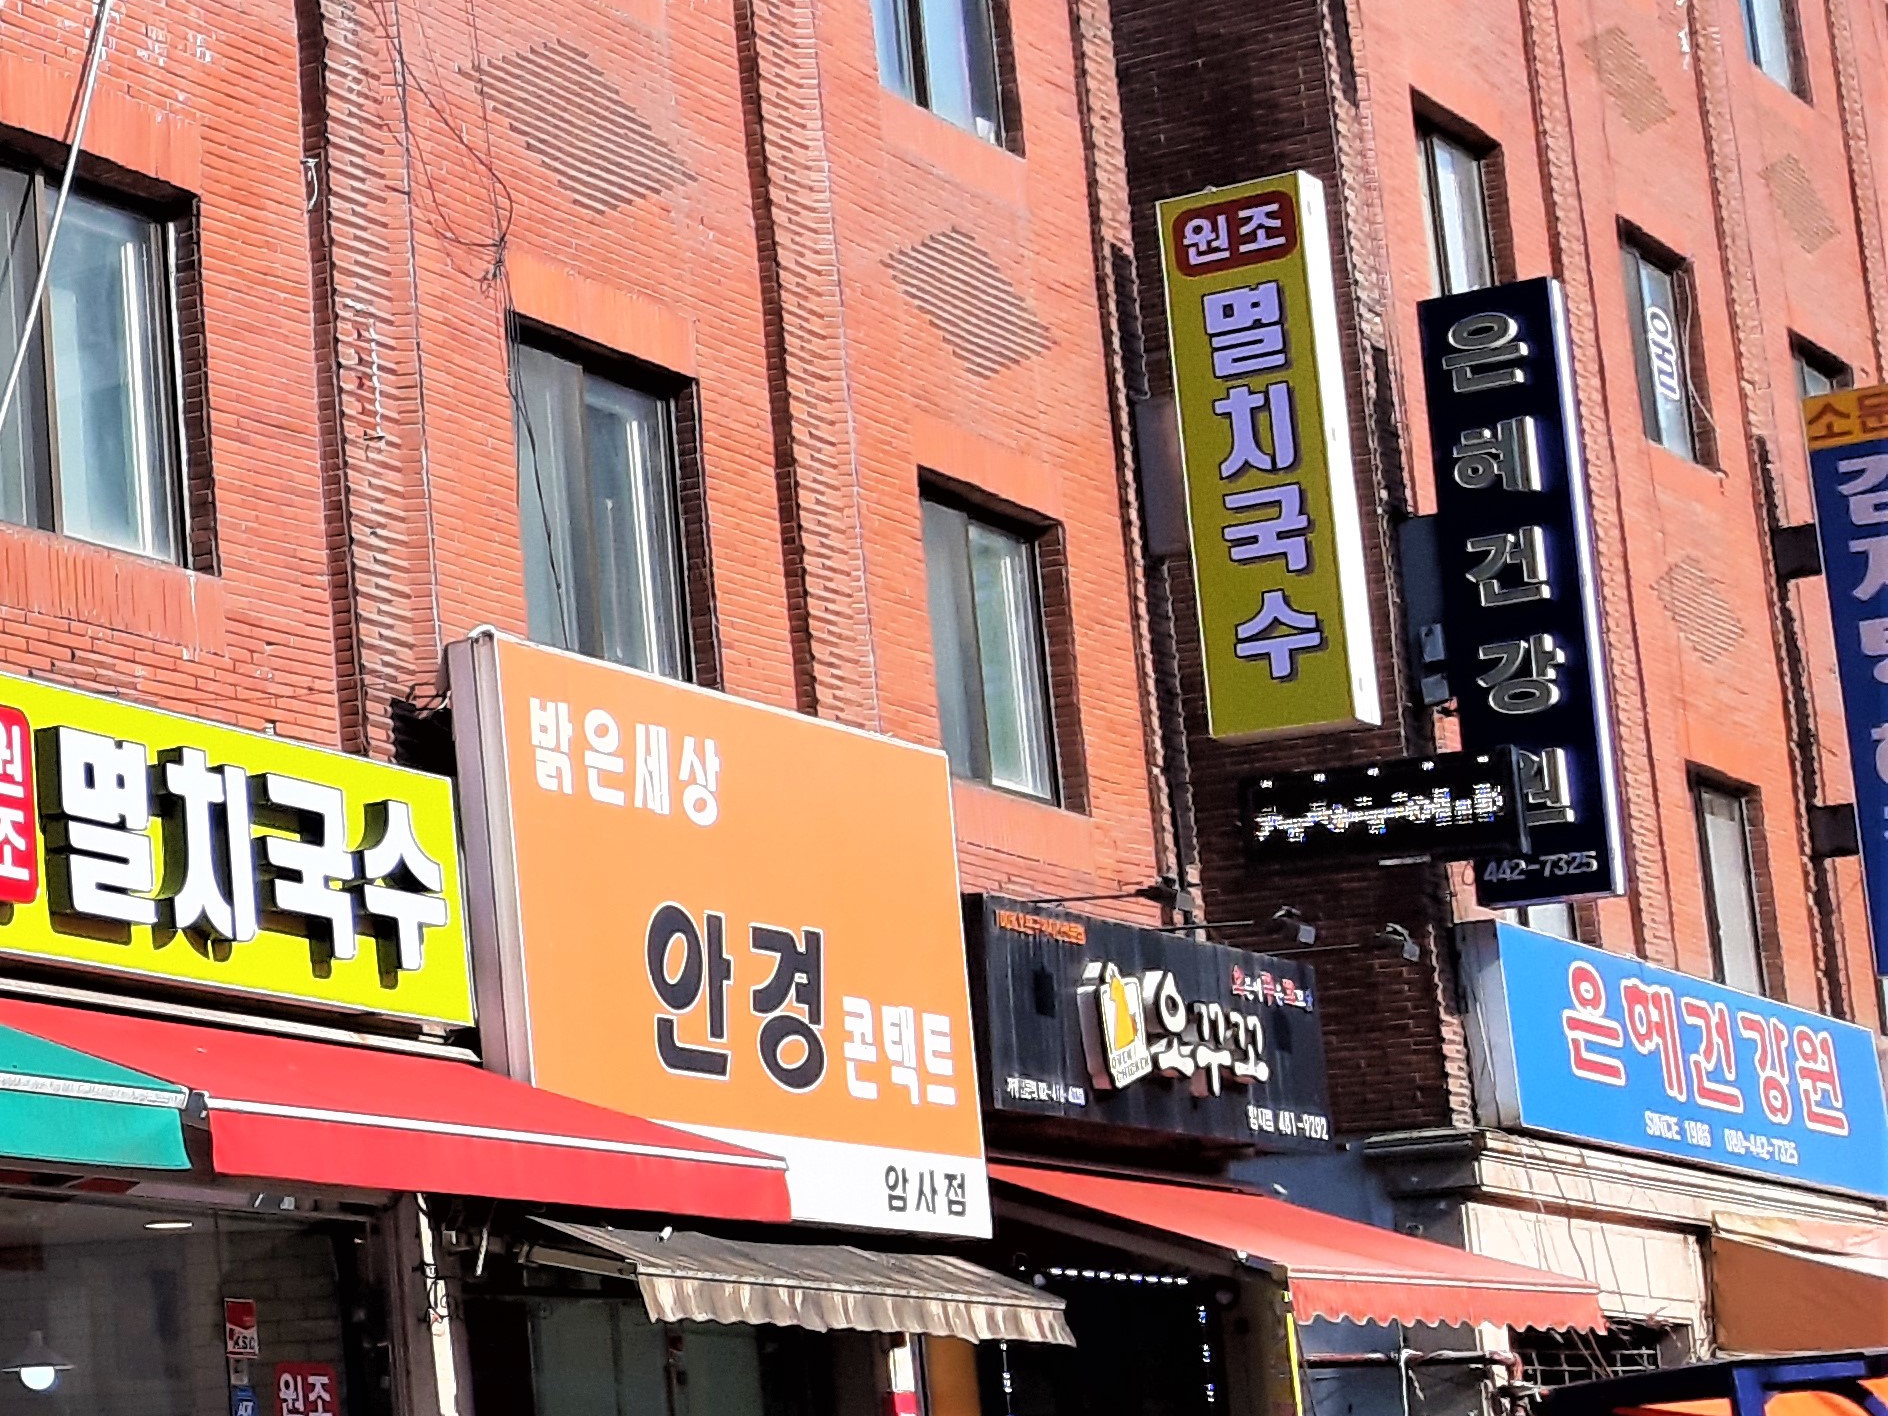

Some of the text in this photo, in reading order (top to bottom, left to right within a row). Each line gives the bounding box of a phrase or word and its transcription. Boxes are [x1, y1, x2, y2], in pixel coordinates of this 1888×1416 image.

[1182, 201, 1286, 264] 원조
[1201, 280, 1324, 681] 멸치국수
[52, 725, 448, 974] 멸치국수
[1483, 850, 1599, 883] 442-7325
[646, 899, 828, 1094] 안경
[885, 1164, 967, 1218] 암사점
